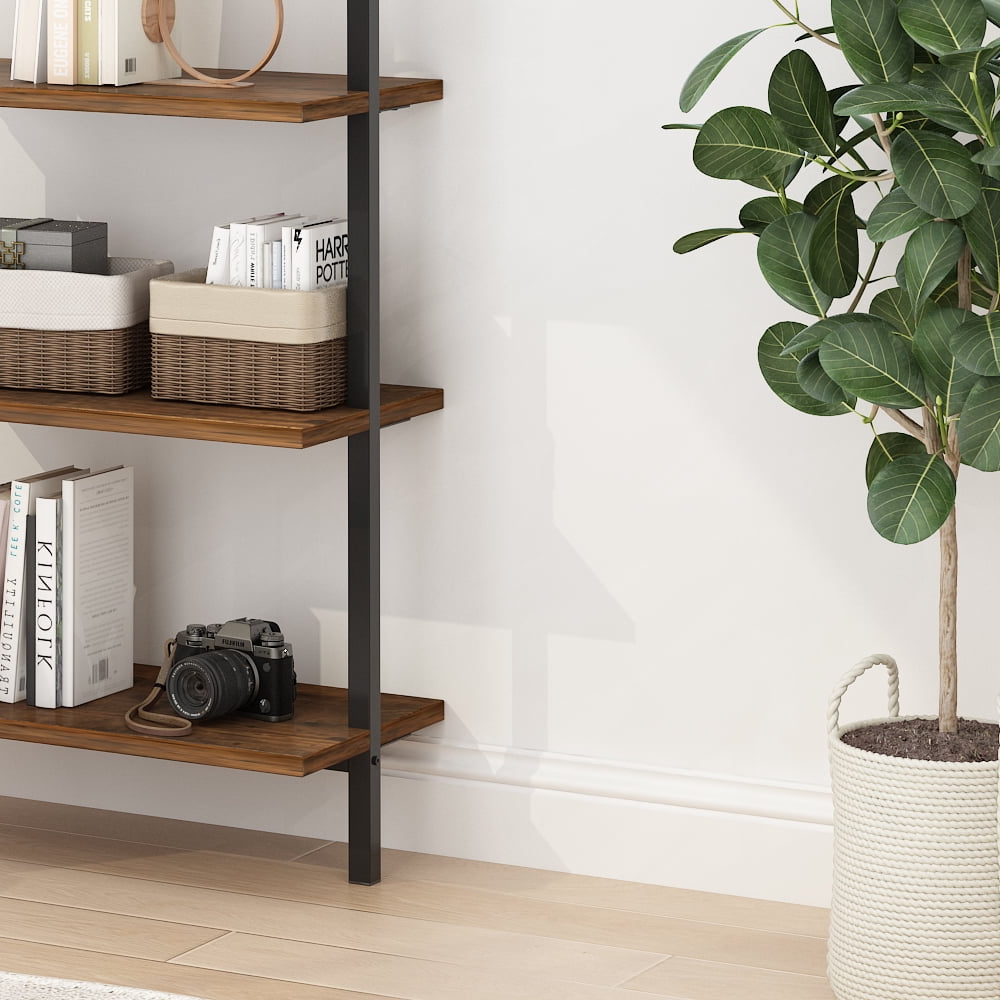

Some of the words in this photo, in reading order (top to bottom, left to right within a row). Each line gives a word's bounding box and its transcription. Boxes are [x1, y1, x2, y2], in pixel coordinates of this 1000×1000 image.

[53, 24, 69, 77] EUGENE
[316, 234, 348, 263] HARR
[316, 260, 348, 285] POTTE
